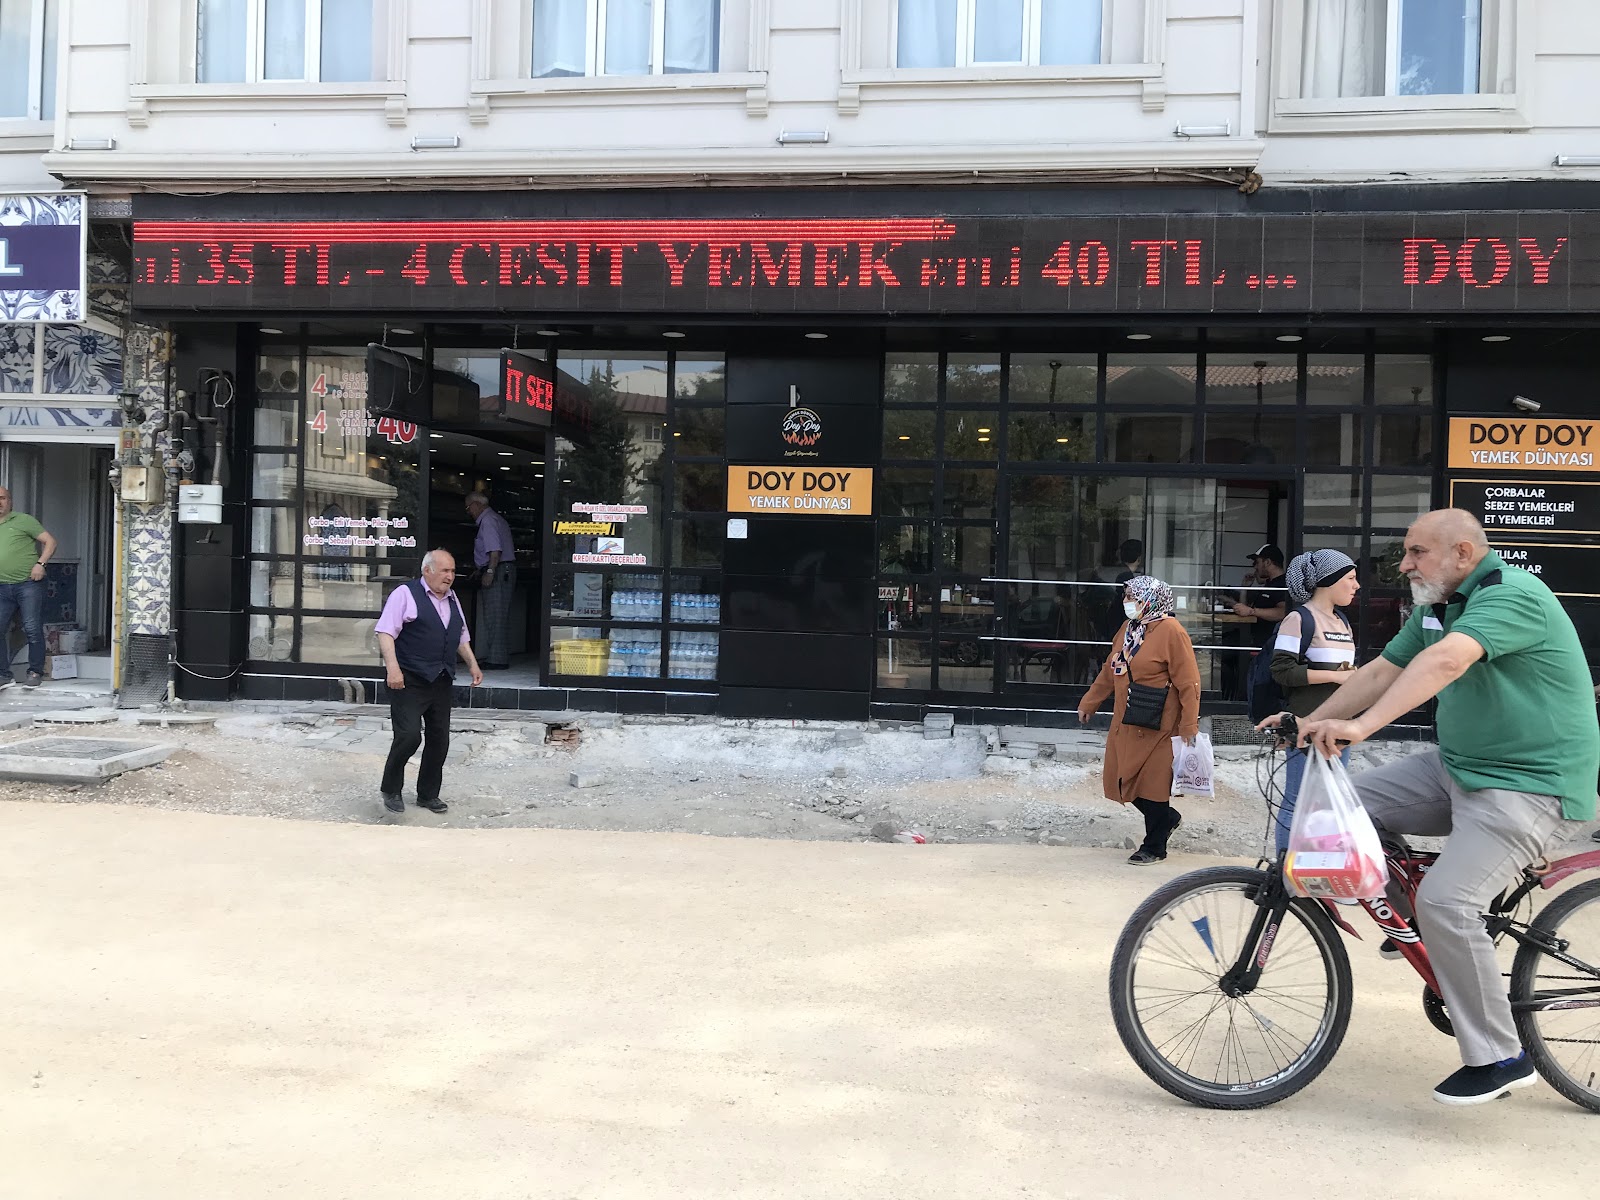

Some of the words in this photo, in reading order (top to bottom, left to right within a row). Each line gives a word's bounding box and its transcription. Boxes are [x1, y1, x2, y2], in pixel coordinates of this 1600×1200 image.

[197, 243, 254, 284] 35
[271, 243, 350, 285] TL
[401, 243, 430, 285] 4
[657, 242, 903, 286] YEMEK
[1041, 240, 1111, 286] 40
[1130, 240, 1226, 285] TL
[1402, 237, 1568, 288] DOY
[310, 373, 329, 398] 4
[339, 381, 368, 390] YEME
[310, 409, 329, 434] 4
[377, 417, 418, 443] 40
[1469, 423, 1527, 445] DOY
[1535, 424, 1593, 446] DOY
[1470, 450, 1520, 464] YEMEK
[1524, 448, 1594, 466] DÜNYASI
[747, 470, 796, 491] DOY
[802, 471, 851, 492] DOY
[748, 495, 790, 508] YEMEK
[793, 493, 852, 510] DÜNYASI
[1484, 487, 1546, 499] ÇORBALAR
[1484, 501, 1515, 511] SEBZE
[1517, 501, 1575, 513] YEMEKLERİ
[1484, 515, 1496, 524] ET
[1497, 514, 1555, 526] YEMEKLERİ
[573, 552, 592, 563] KREDİ
[592, 554, 610, 564] KARTI
